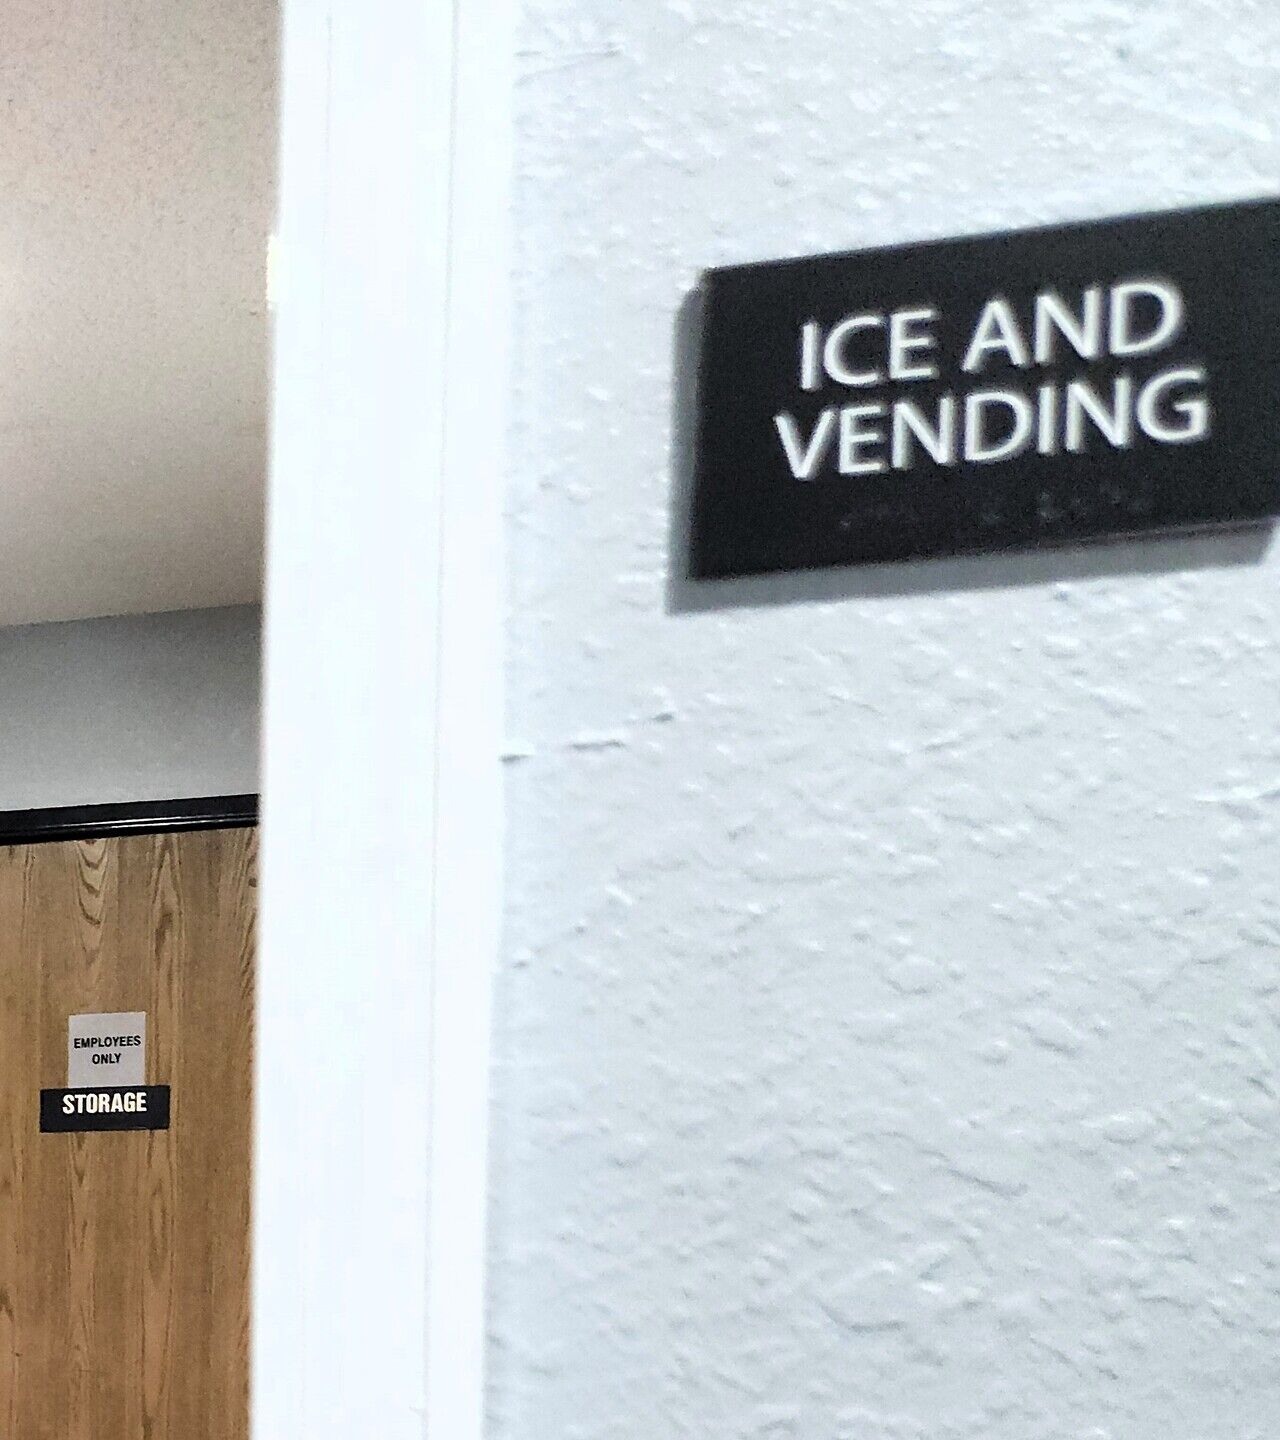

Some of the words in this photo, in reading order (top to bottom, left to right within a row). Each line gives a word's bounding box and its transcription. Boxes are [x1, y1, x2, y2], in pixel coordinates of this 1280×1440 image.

[799, 307, 938, 391] ICE
[961, 281, 1184, 373] AND
[773, 367, 1211, 481] VENDING
[73, 1035, 142, 1049] EMPLOYEES
[91, 1053, 122, 1065] ONLY
[62, 1091, 148, 1115] STORAGE
